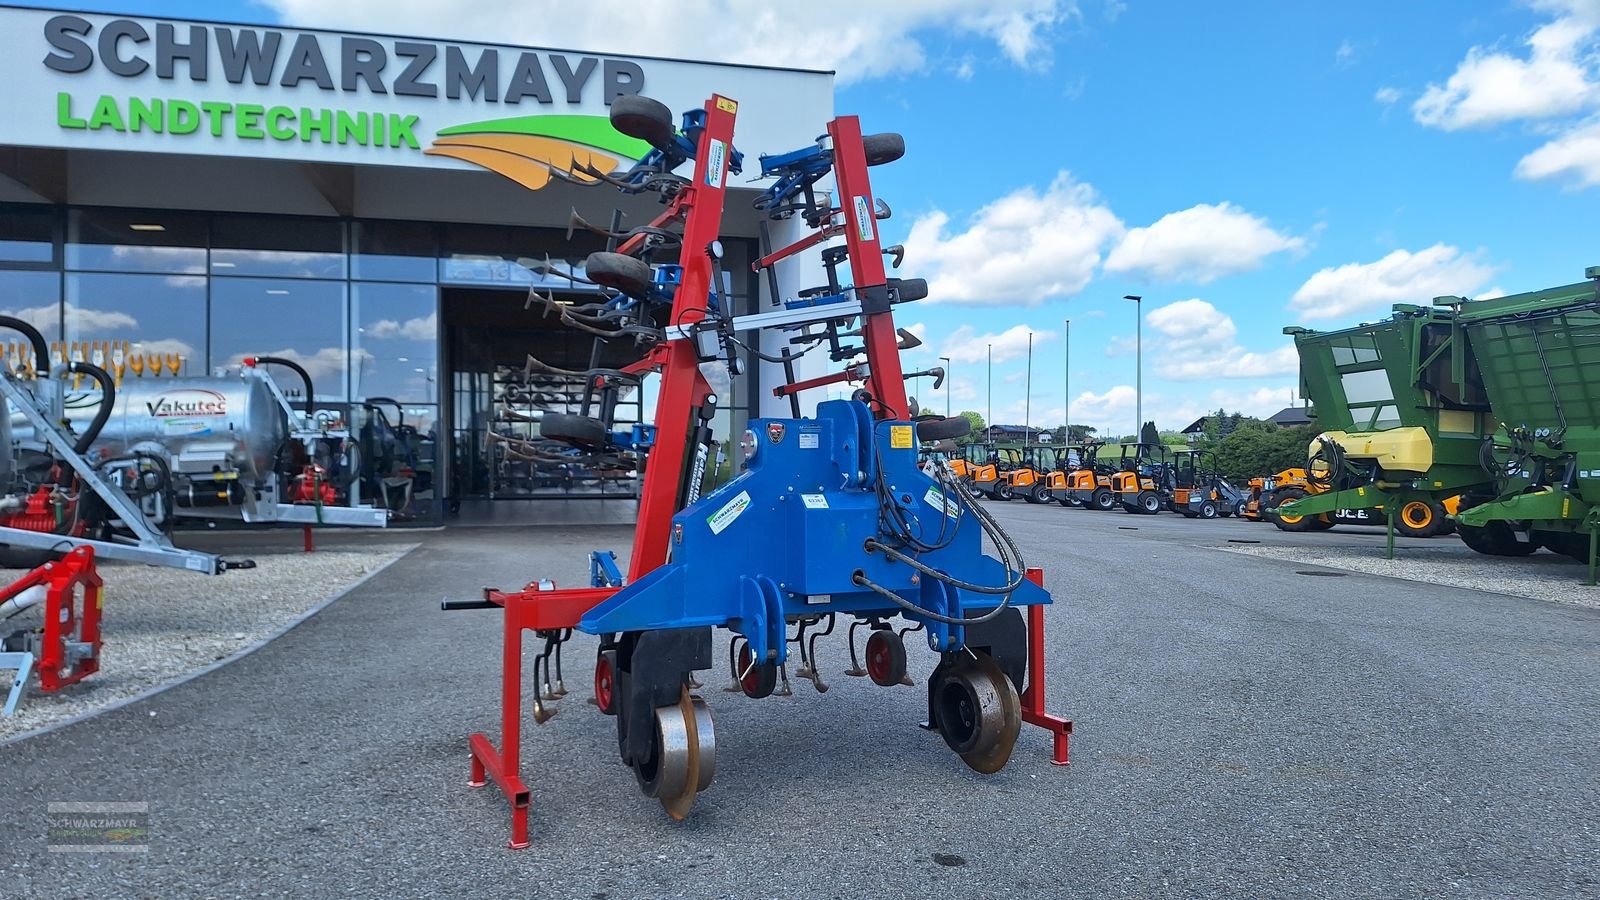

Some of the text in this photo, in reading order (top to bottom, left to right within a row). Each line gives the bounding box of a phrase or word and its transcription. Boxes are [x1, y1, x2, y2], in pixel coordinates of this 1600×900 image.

[42, 14, 646, 106] SCHWARZMAYR
[56, 91, 422, 150] LANDTECHNIK
[146, 397, 227, 417] Vakutec
